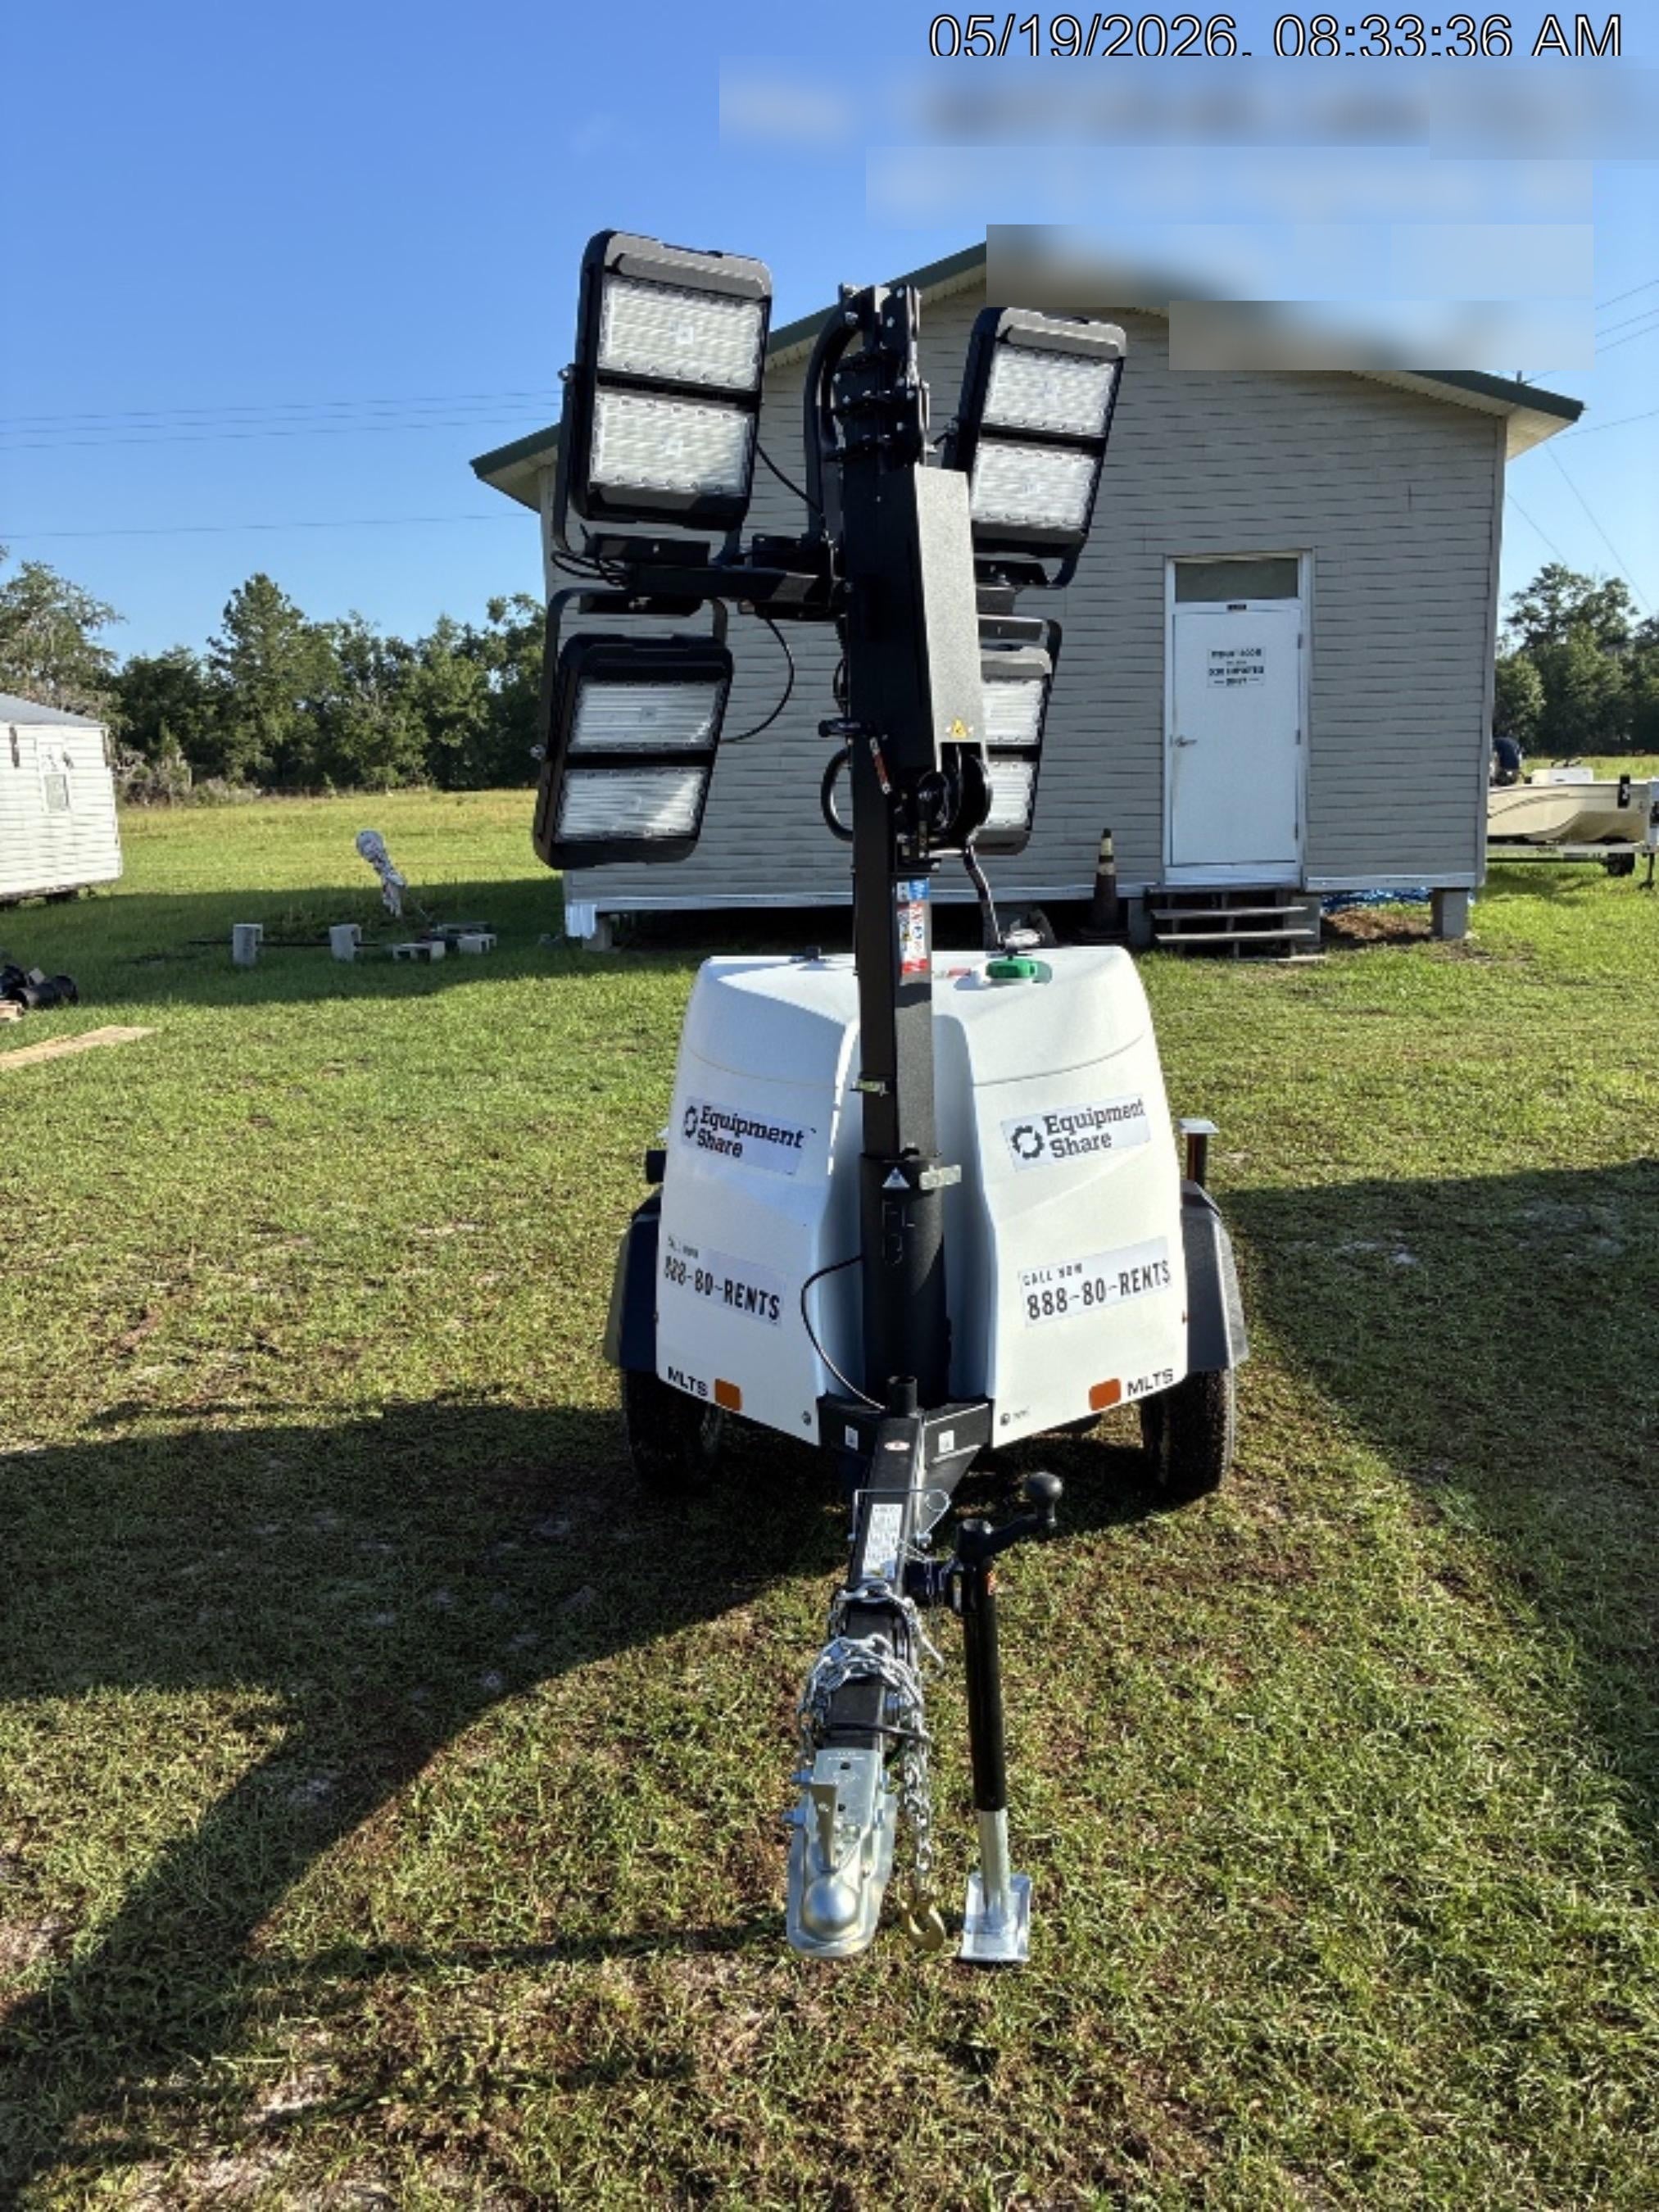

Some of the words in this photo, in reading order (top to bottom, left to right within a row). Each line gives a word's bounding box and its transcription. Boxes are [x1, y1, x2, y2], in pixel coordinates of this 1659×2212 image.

[700, 1105, 804, 1148] Equipment
[1043, 1098, 1145, 1135] Equipment
[697, 1128, 742, 1158] Share
[1049, 1133, 1112, 1158] Share
[1027, 1259, 1171, 1320] 888-80-RENTS
[668, 1366, 708, 1396] MLTS
[1127, 1368, 1173, 1396] MLTS
